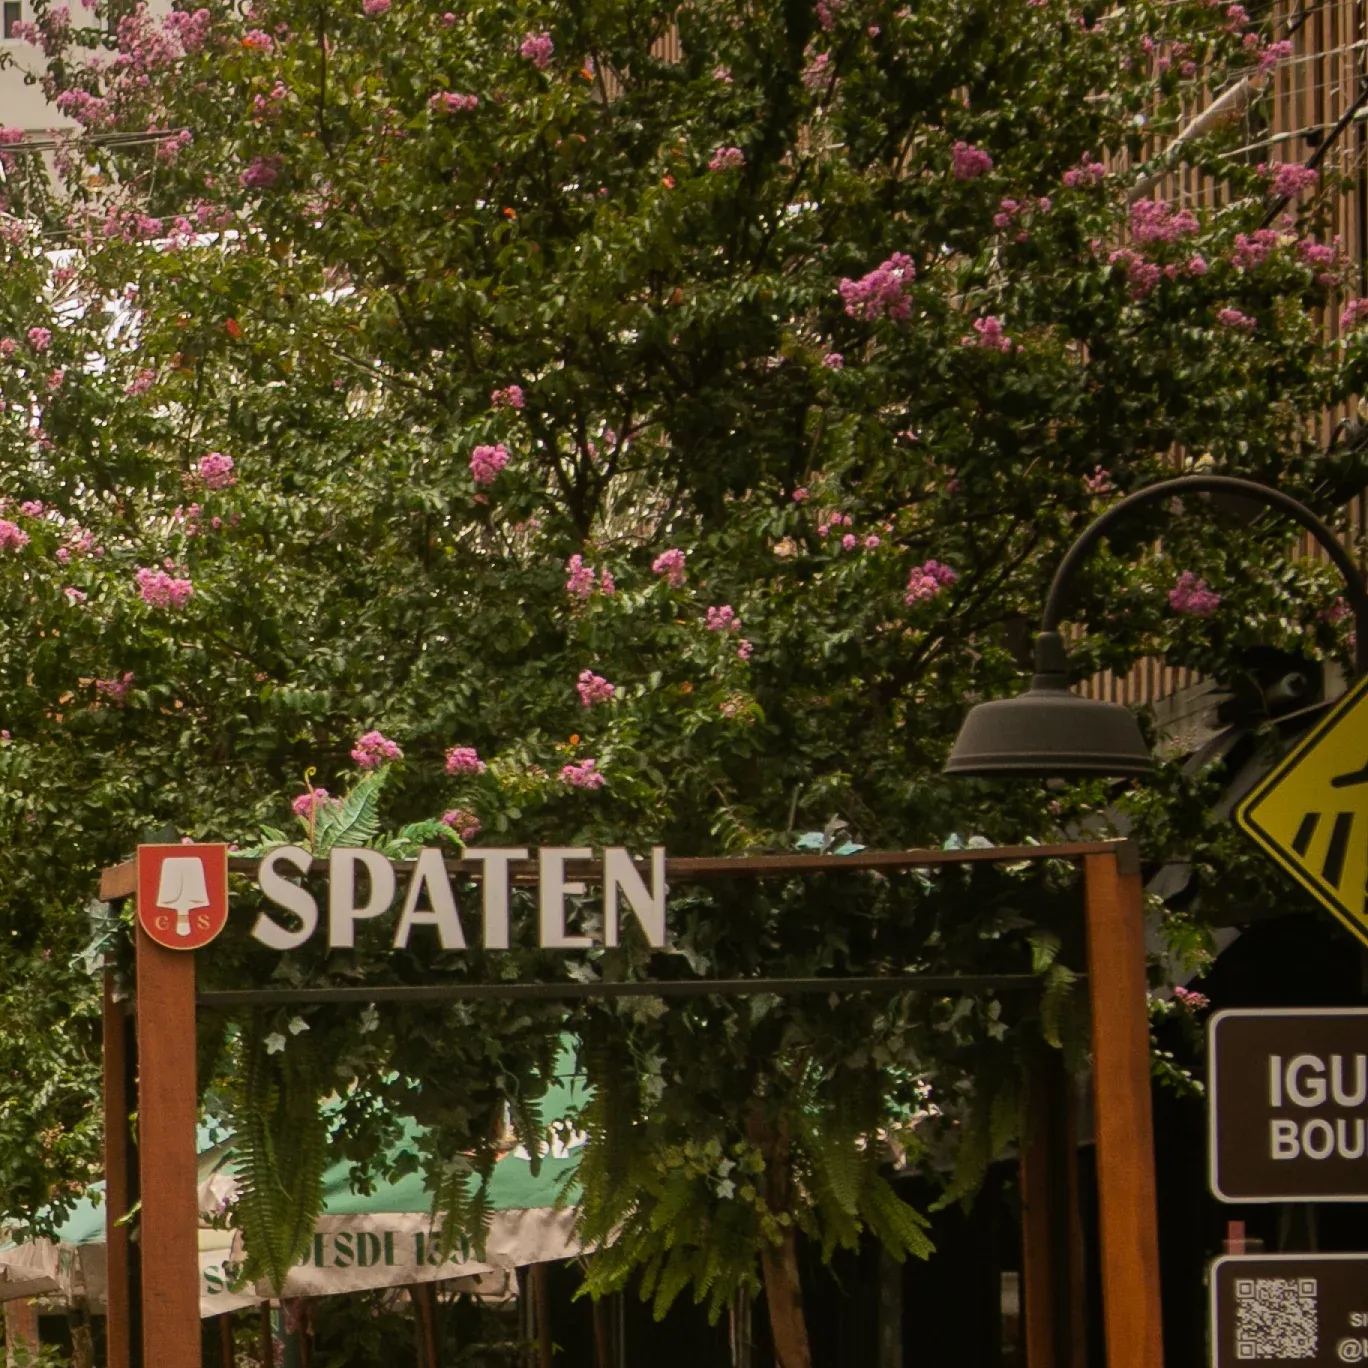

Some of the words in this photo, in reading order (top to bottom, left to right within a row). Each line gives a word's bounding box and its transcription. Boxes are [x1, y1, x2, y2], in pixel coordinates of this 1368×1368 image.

[250, 846, 666, 950] SPATEN
[1270, 1054, 1368, 1108] IGU
[1271, 1118, 1368, 1160] BOU
